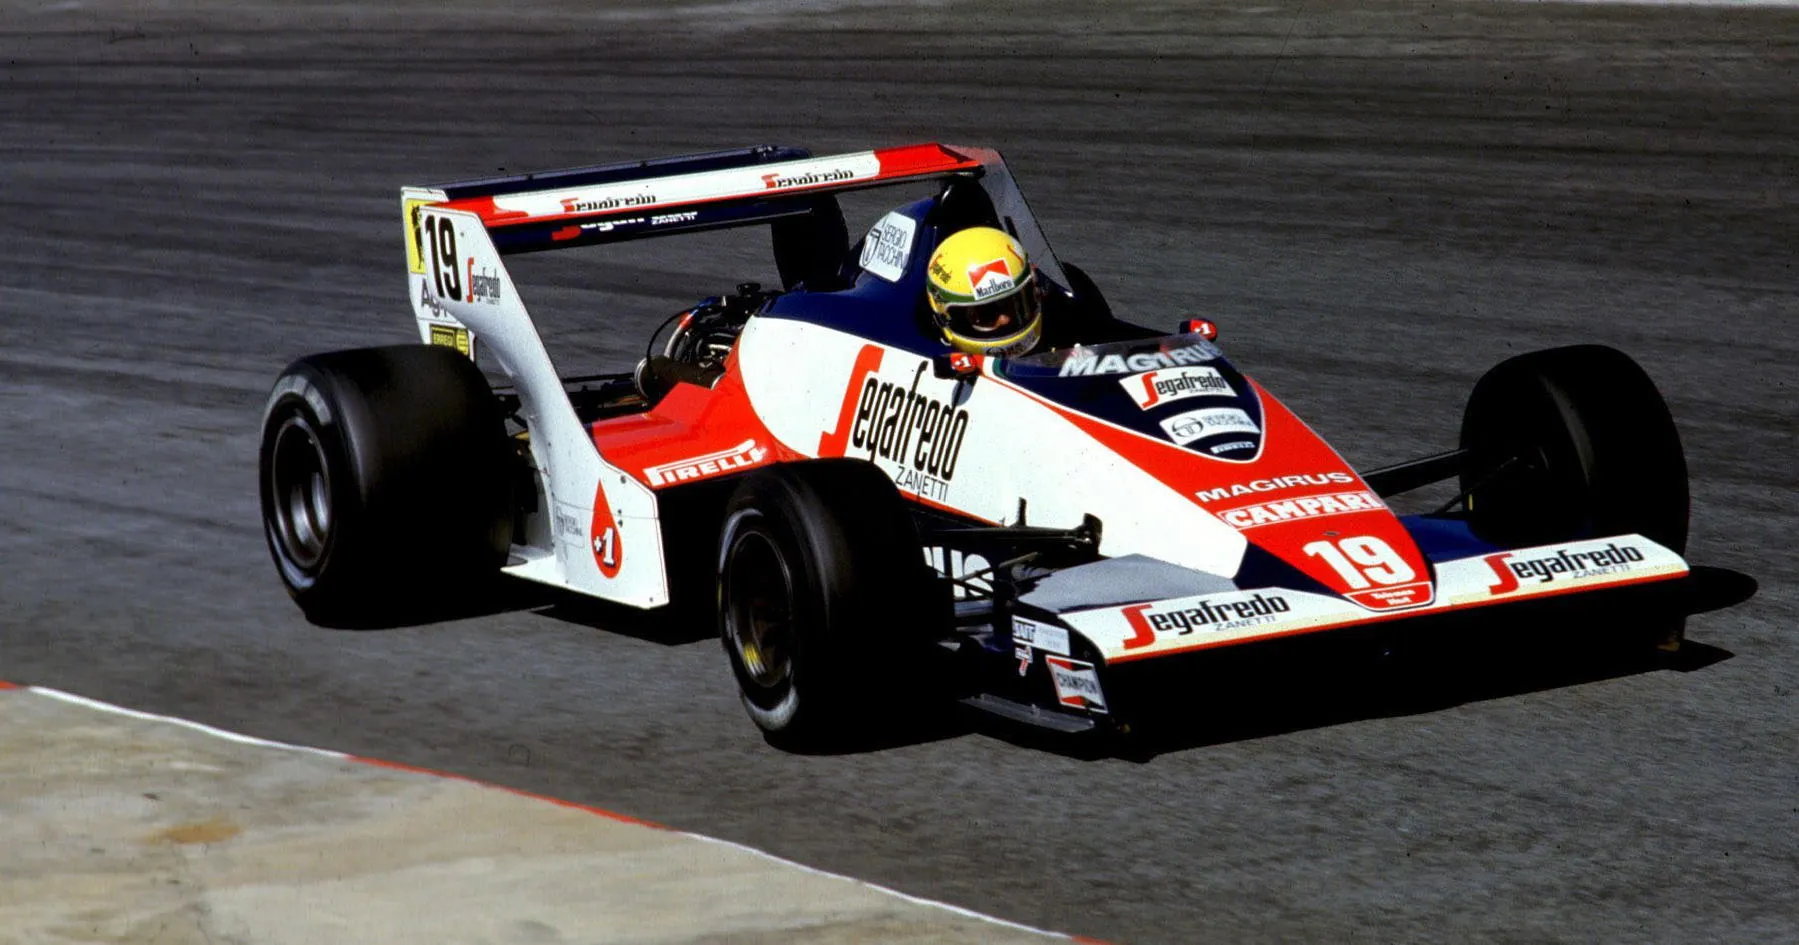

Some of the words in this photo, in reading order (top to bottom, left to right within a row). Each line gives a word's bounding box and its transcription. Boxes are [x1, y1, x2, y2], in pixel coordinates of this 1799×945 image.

[425, 215, 462, 302] 19
[976, 278, 1013, 298] Marlboro
[1142, 370, 1226, 408] Segafredo
[817, 344, 968, 481] Segafredo
[643, 439, 768, 486] PIRELLI
[895, 466, 948, 503] ZANETTI
[1195, 472, 1354, 502] MAGIRUS
[1225, 493, 1384, 528] CAMPARI
[1302, 536, 1416, 589] 19
[1483, 543, 1645, 595] Segafredo
[1573, 565, 1631, 579] ZANETTI
[1121, 594, 1291, 649] Segafredo
[1217, 615, 1276, 631] ZANETTI
[1056, 672, 1098, 695] CHAMPION
